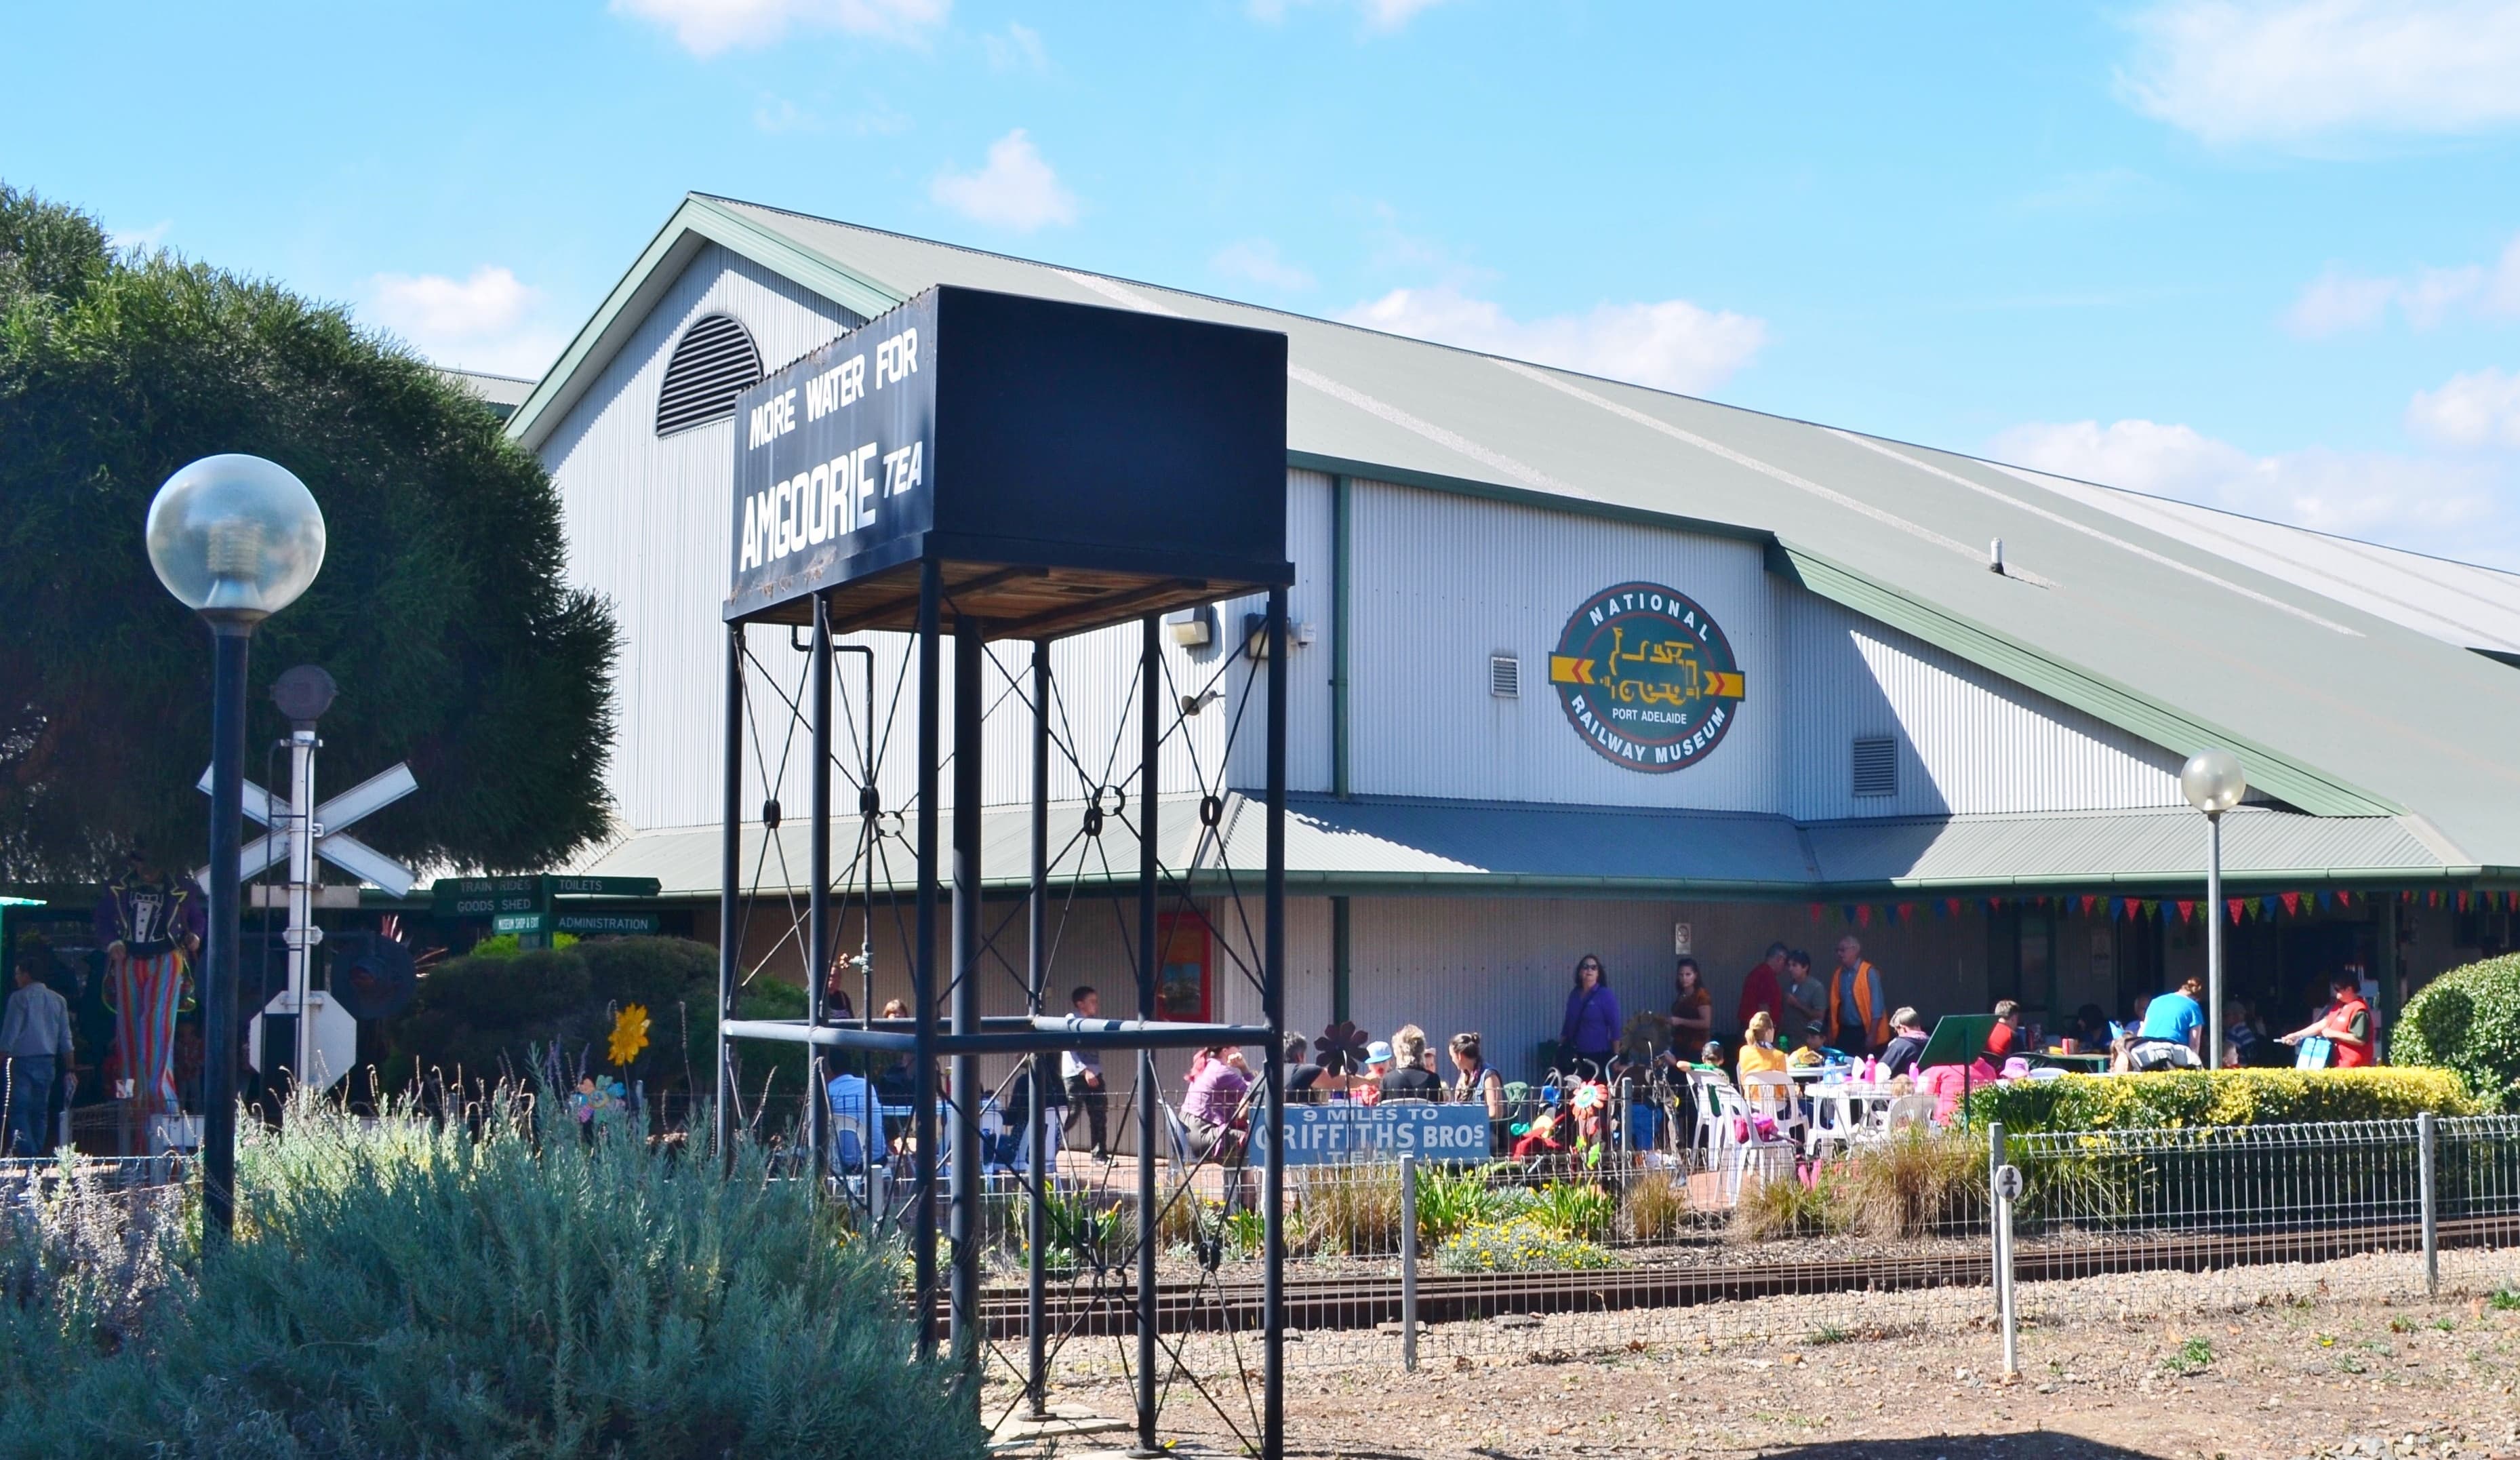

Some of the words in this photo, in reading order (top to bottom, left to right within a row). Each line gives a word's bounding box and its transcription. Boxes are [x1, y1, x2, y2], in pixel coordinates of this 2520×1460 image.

[749, 388, 796, 450] MORE
[806, 354, 864, 422] WATER
[877, 328, 918, 390] FOR
[740, 442, 877, 572] AMGOORIE
[883, 441, 923, 498] TEA
[1589, 593, 1708, 642] NATIONAL
[1612, 708, 1638, 720] PORT
[1641, 711, 1687, 724] ADELAIDE
[1572, 694, 1646, 762] RAILWAY
[1655, 706, 1725, 764] MUSEUM
[460, 881, 492, 893] TRAIN
[499, 880, 532, 891] RIDES
[559, 880, 602, 891] TOILETS
[457, 900, 494, 912] GOODS
[501, 899, 531, 910] SHED
[559, 918, 648, 930] ADMINISTRATION
[1302, 1109, 1317, 1122] 9
[1327, 1109, 1397, 1122] MILES
[1407, 1108, 1438, 1120] TO
[1327, 1151, 1414, 1164] TEA
